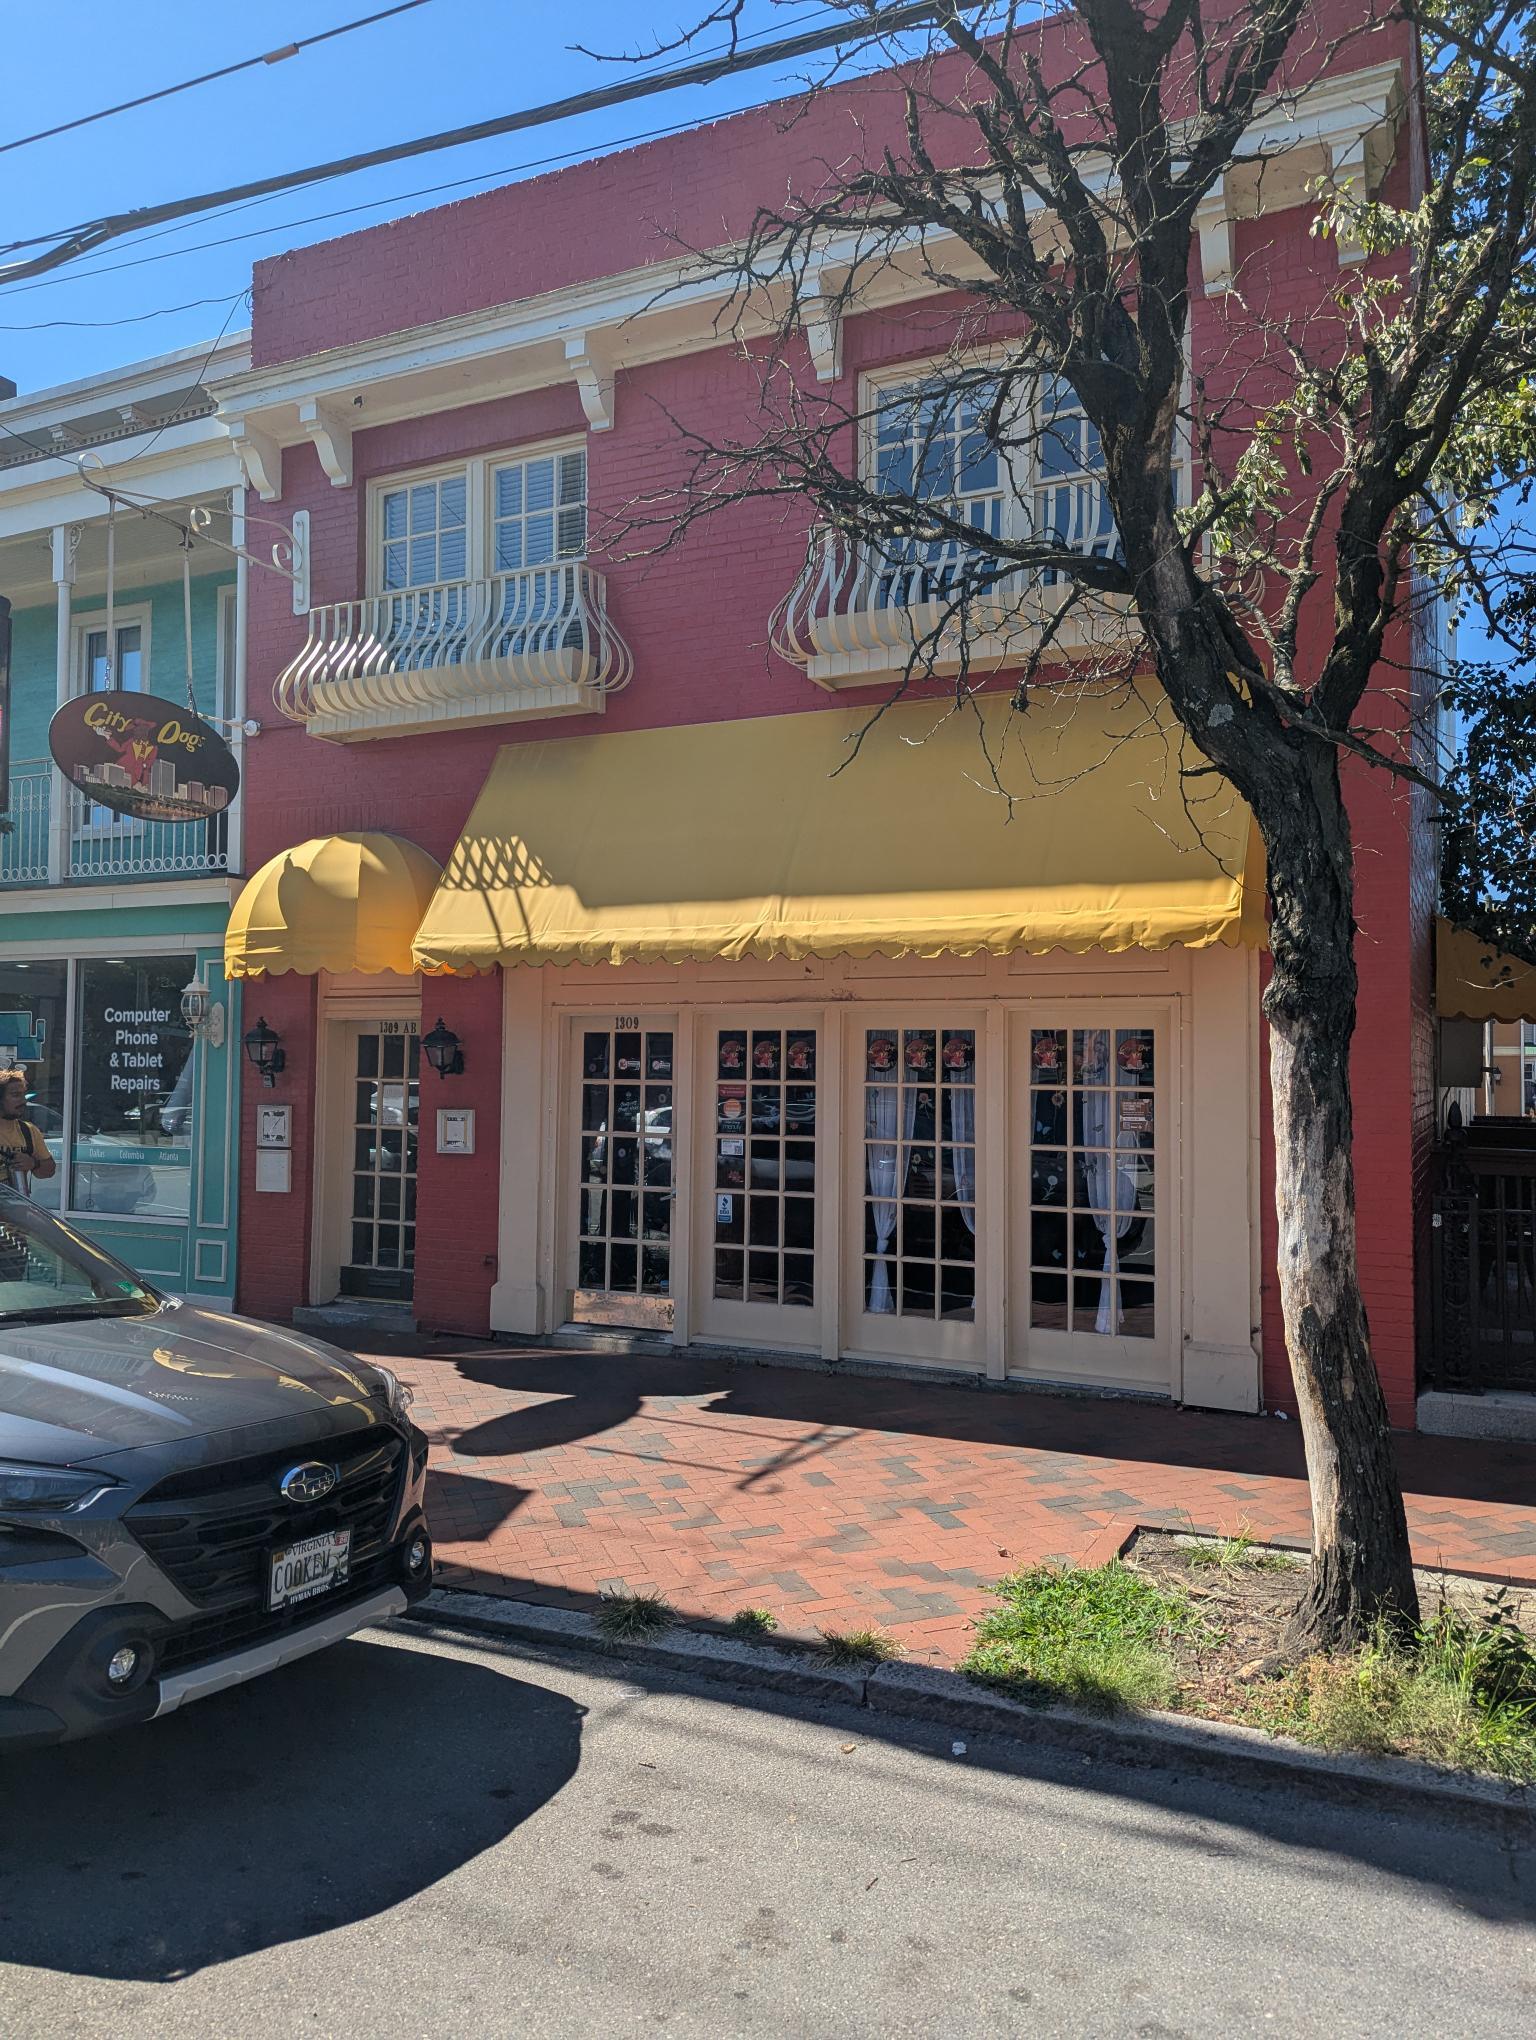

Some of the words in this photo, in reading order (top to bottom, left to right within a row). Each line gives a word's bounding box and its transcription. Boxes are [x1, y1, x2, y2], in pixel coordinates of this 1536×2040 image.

[84, 702, 133, 732] City
[157, 720, 206, 752] Dogs
[104, 1007, 171, 1026] Computer
[615, 1016, 639, 1030] 1309
[379, 1021, 399, 1034] 1309
[115, 1030, 158, 1045] Phone
[109, 1052, 119, 1068] &
[122, 1052, 163, 1068] Tablet
[111, 1074, 160, 1094] Repairs
[292, 1536, 331, 1556] VIRGINIA
[290, 1590, 311, 1605] HYMAN
